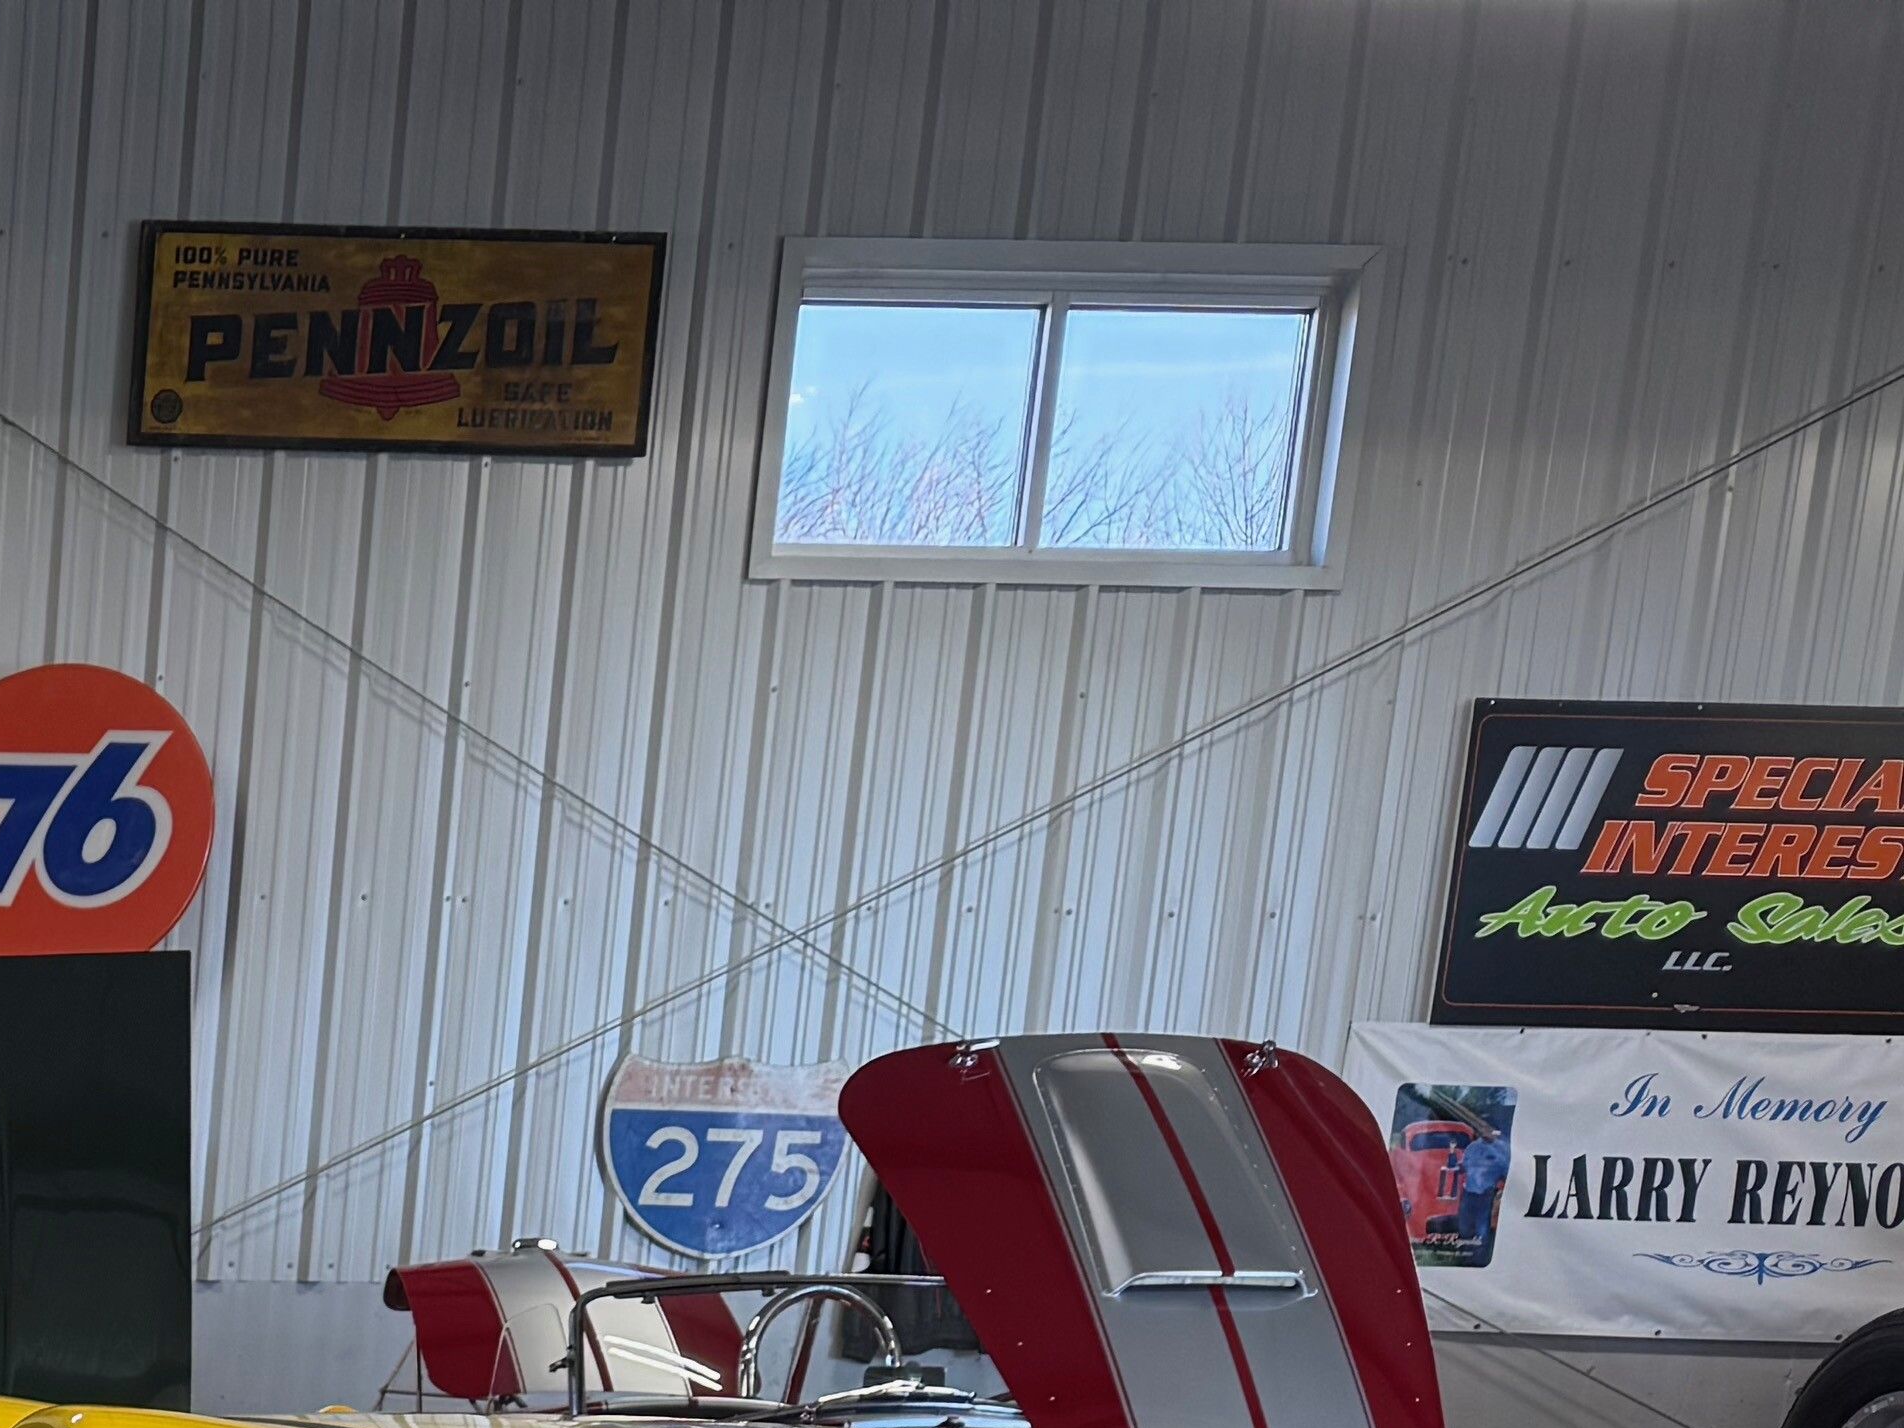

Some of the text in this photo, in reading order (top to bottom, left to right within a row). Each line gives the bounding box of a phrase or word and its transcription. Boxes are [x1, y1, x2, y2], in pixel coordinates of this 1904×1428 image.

[173, 270, 331, 293] PENNSYLVANIA
[174, 245, 300, 268] 100% PURE
[184, 299, 621, 382] PENNZOIL
[1635, 753, 1904, 814] SPECIA
[1580, 820, 1904, 880] INTERES
[1474, 885, 1904, 946] Auto Sales
[1662, 950, 1733, 973] LLC.
[649, 1074, 792, 1101] INTERS
[1609, 1071, 1889, 1144] In Memory
[638, 1125, 823, 1212] 275
[1524, 1153, 1904, 1230] LARRY REYNO
